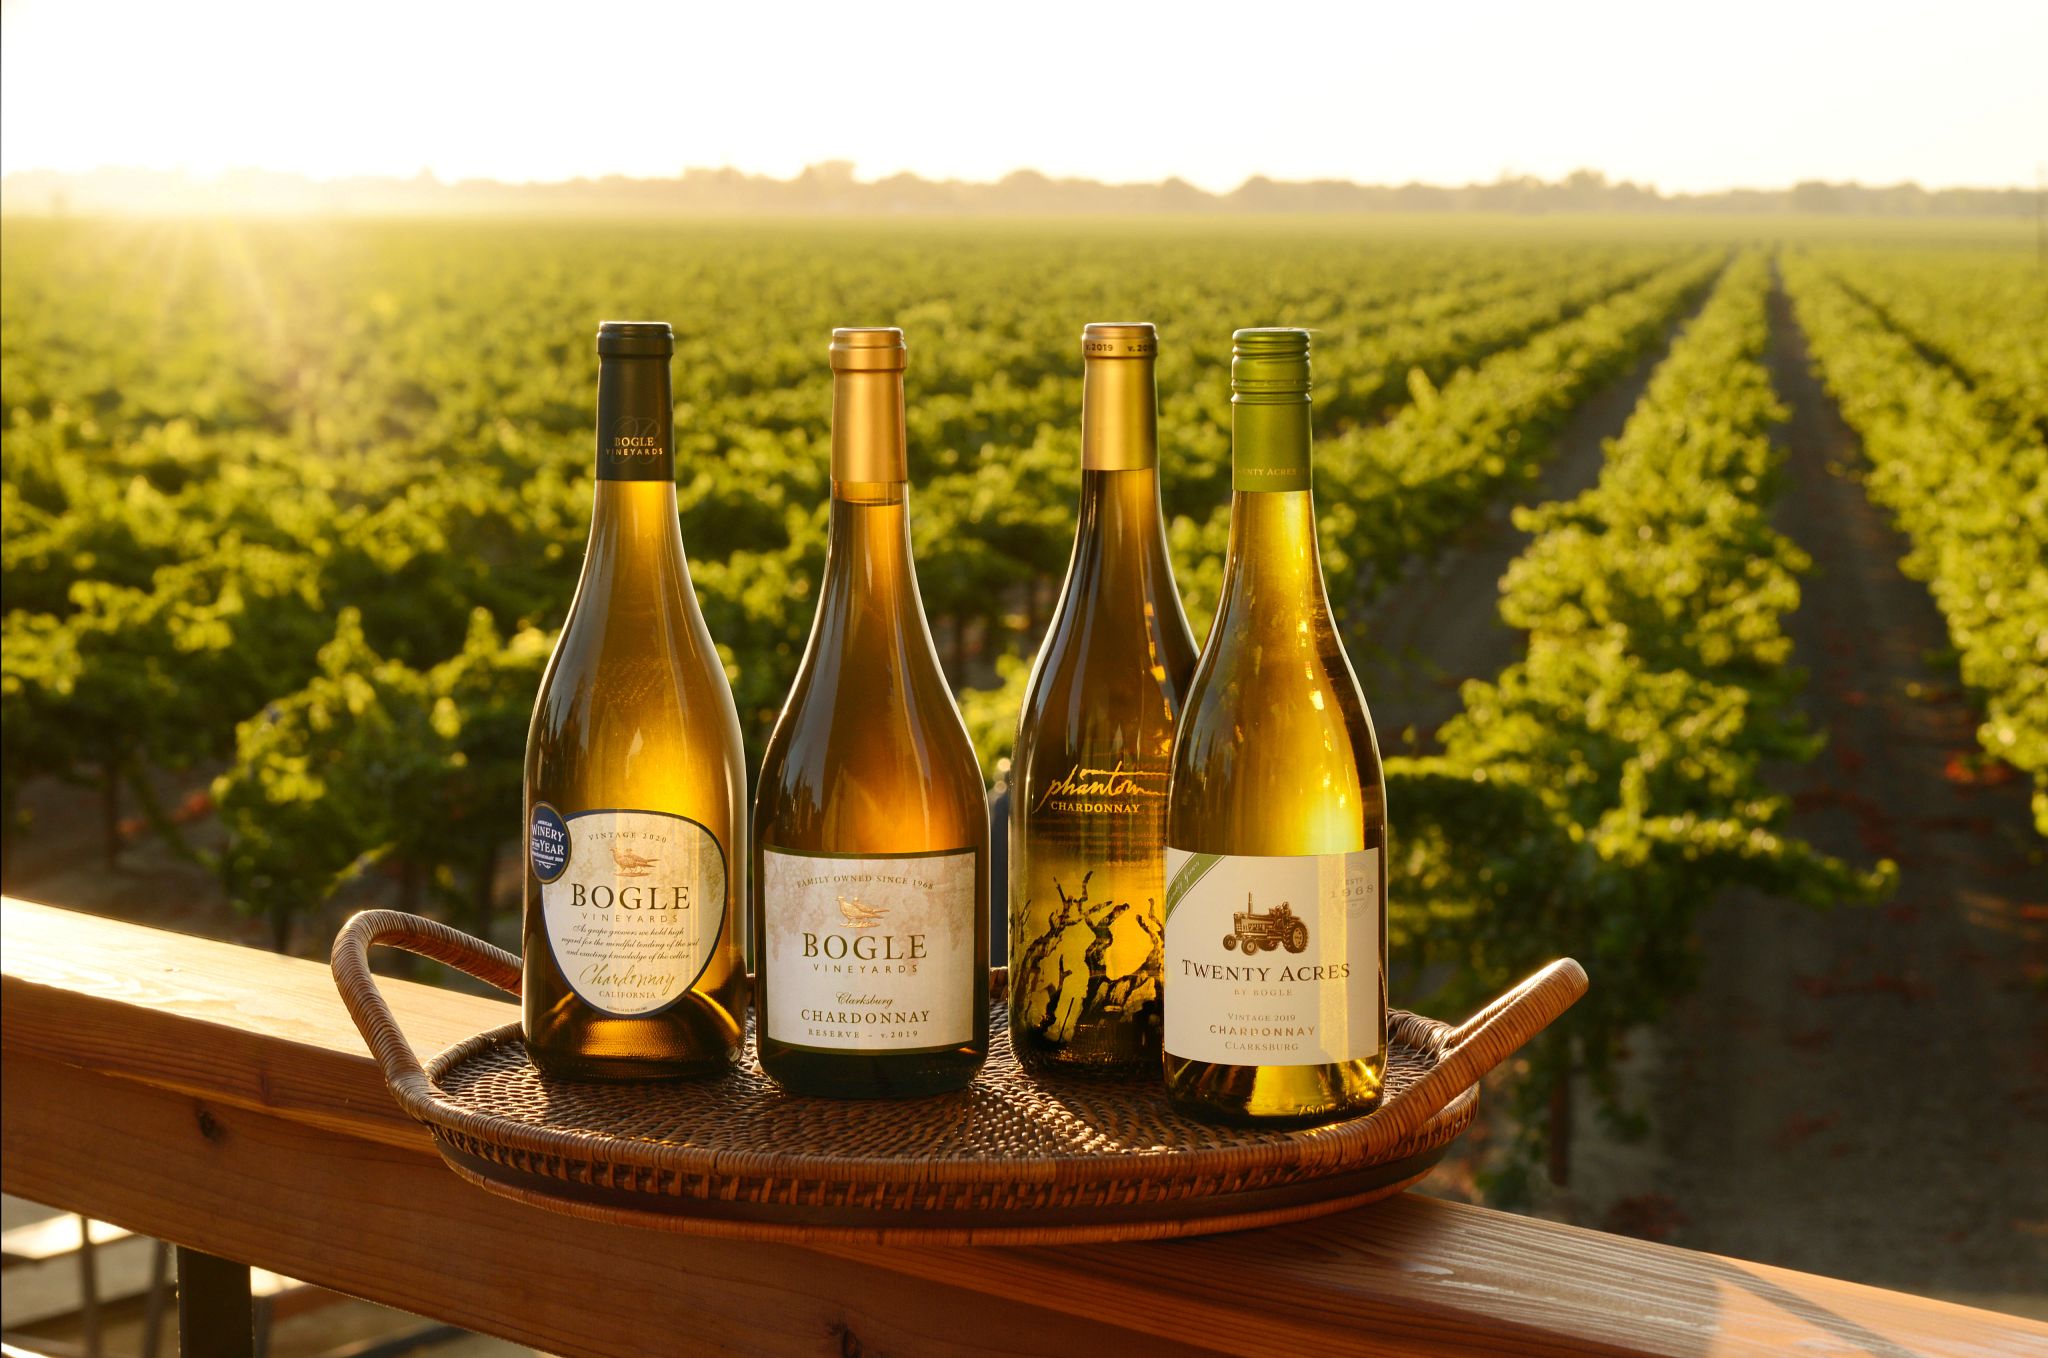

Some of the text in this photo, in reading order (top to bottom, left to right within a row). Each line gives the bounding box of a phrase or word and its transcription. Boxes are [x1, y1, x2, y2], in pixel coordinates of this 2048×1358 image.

[615, 437, 654, 447] BOGLE
[606, 448, 663, 456] VINEYARDS
[1032, 760, 1168, 814] phantom
[1051, 801, 1140, 813] CHARDONNAY
[532, 823, 565, 842] WINERY
[588, 831, 667, 843] VINTAGE 2020
[540, 840, 565, 856] YEAR
[797, 875, 935, 890] FAMILY OWNED SINCE 1968
[571, 883, 691, 910] BOGLE
[582, 912, 678, 923] VINEYARDS
[668, 927, 685, 938] high
[594, 938, 603, 946] the
[802, 932, 928, 960] BOGLE
[813, 963, 918, 974] VINEYARDS
[1182, 959, 1351, 982] TWENTY ACRES
[579, 963, 676, 996] Chardonnay
[598, 990, 656, 999] CALIFORNIA
[1234, 988, 1294, 997] BY BOGLE
[836, 992, 894, 1009] Clarksburg
[801, 1009, 931, 1024] CHARDONNAY
[1227, 1012, 1297, 1022] VINTAGE 2019
[808, 1028, 860, 1038] RESERVE
[880, 1029, 919, 1039] v.2019
[1209, 1024, 1316, 1037] CHARDONNAY
[1224, 1041, 1300, 1052] CLARKSBURG
